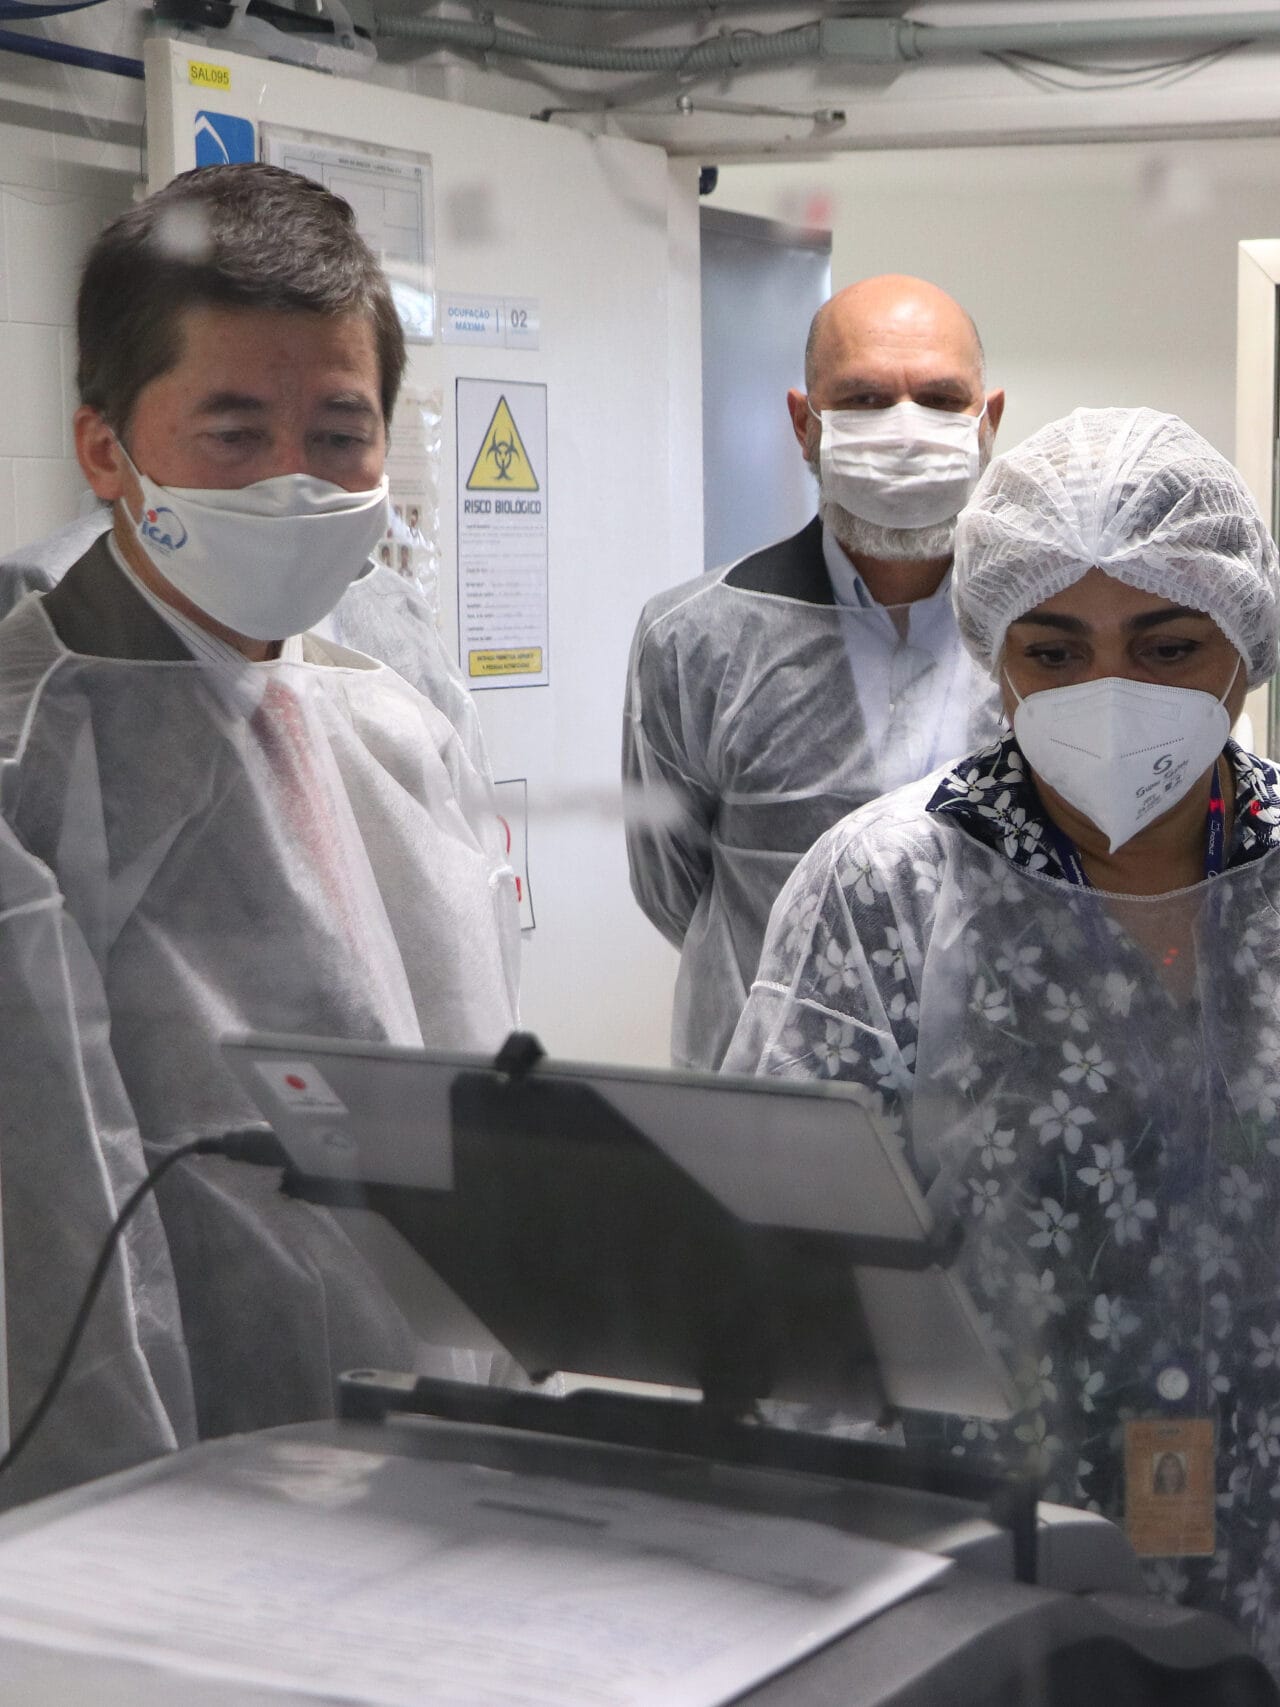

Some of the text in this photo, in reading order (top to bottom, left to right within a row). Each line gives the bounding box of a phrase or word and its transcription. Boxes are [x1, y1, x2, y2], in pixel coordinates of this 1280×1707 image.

[191, 65, 230, 85] SAL095
[511, 309, 528, 328] 02
[464, 500, 492, 514] RISCO
